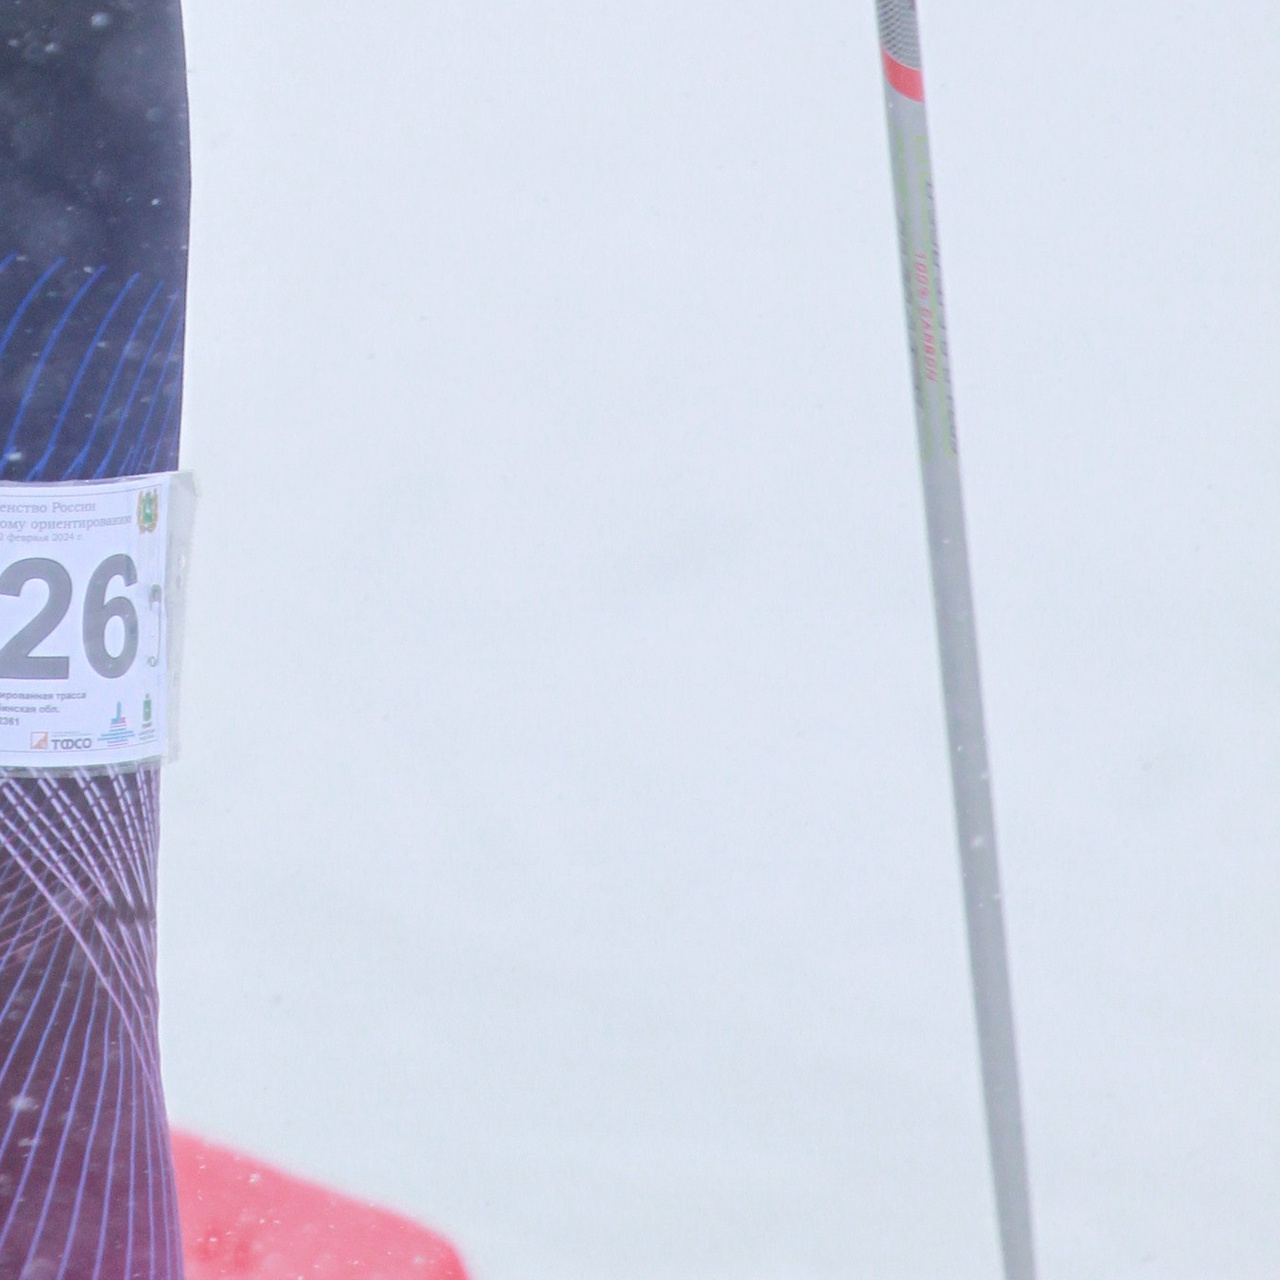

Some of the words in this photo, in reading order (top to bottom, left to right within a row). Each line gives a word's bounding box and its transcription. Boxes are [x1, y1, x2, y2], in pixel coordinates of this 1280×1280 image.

[918, 306, 939, 382] CARBON
[52, 501, 96, 514] России
[52, 532, 74, 542] 2024
[56, 691, 87, 702] трасса
[39, 704, 61, 714] обл.
